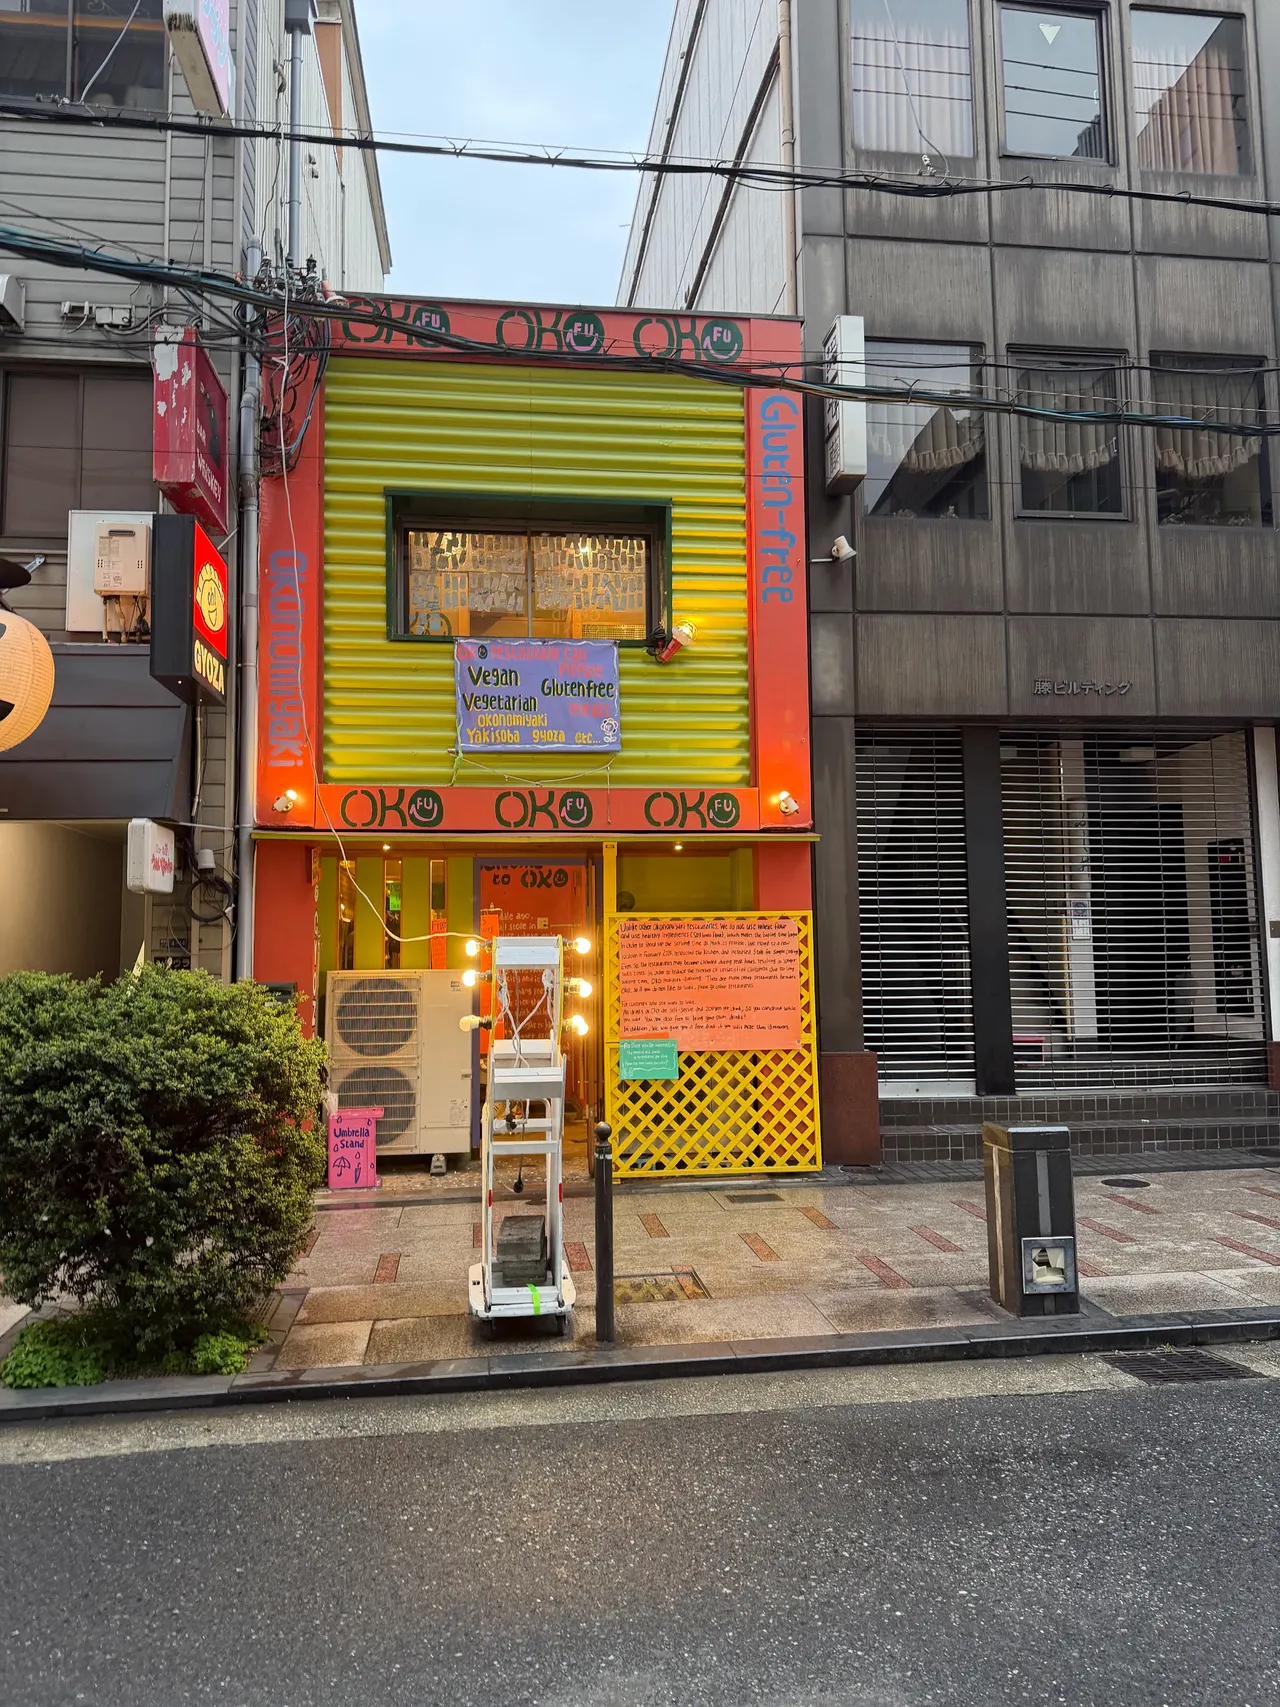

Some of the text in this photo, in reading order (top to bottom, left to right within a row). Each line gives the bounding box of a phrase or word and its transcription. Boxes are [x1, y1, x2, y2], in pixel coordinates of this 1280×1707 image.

[761, 395, 799, 604] Gluten-free
[563, 647, 587, 663] can
[194, 639, 224, 695] GYOZA
[467, 666, 520, 688] Vegan
[1033, 679, 1132, 695] 藤ビルディング
[462, 692, 539, 712] Vegetarian
[569, 702, 610, 718] meals
[466, 727, 520, 744] Yakisoba
[532, 729, 566, 744] gyoza
[492, 872, 511, 886] to
[333, 1127, 370, 1138] Umbrella
[340, 1139, 365, 1149] Stand
